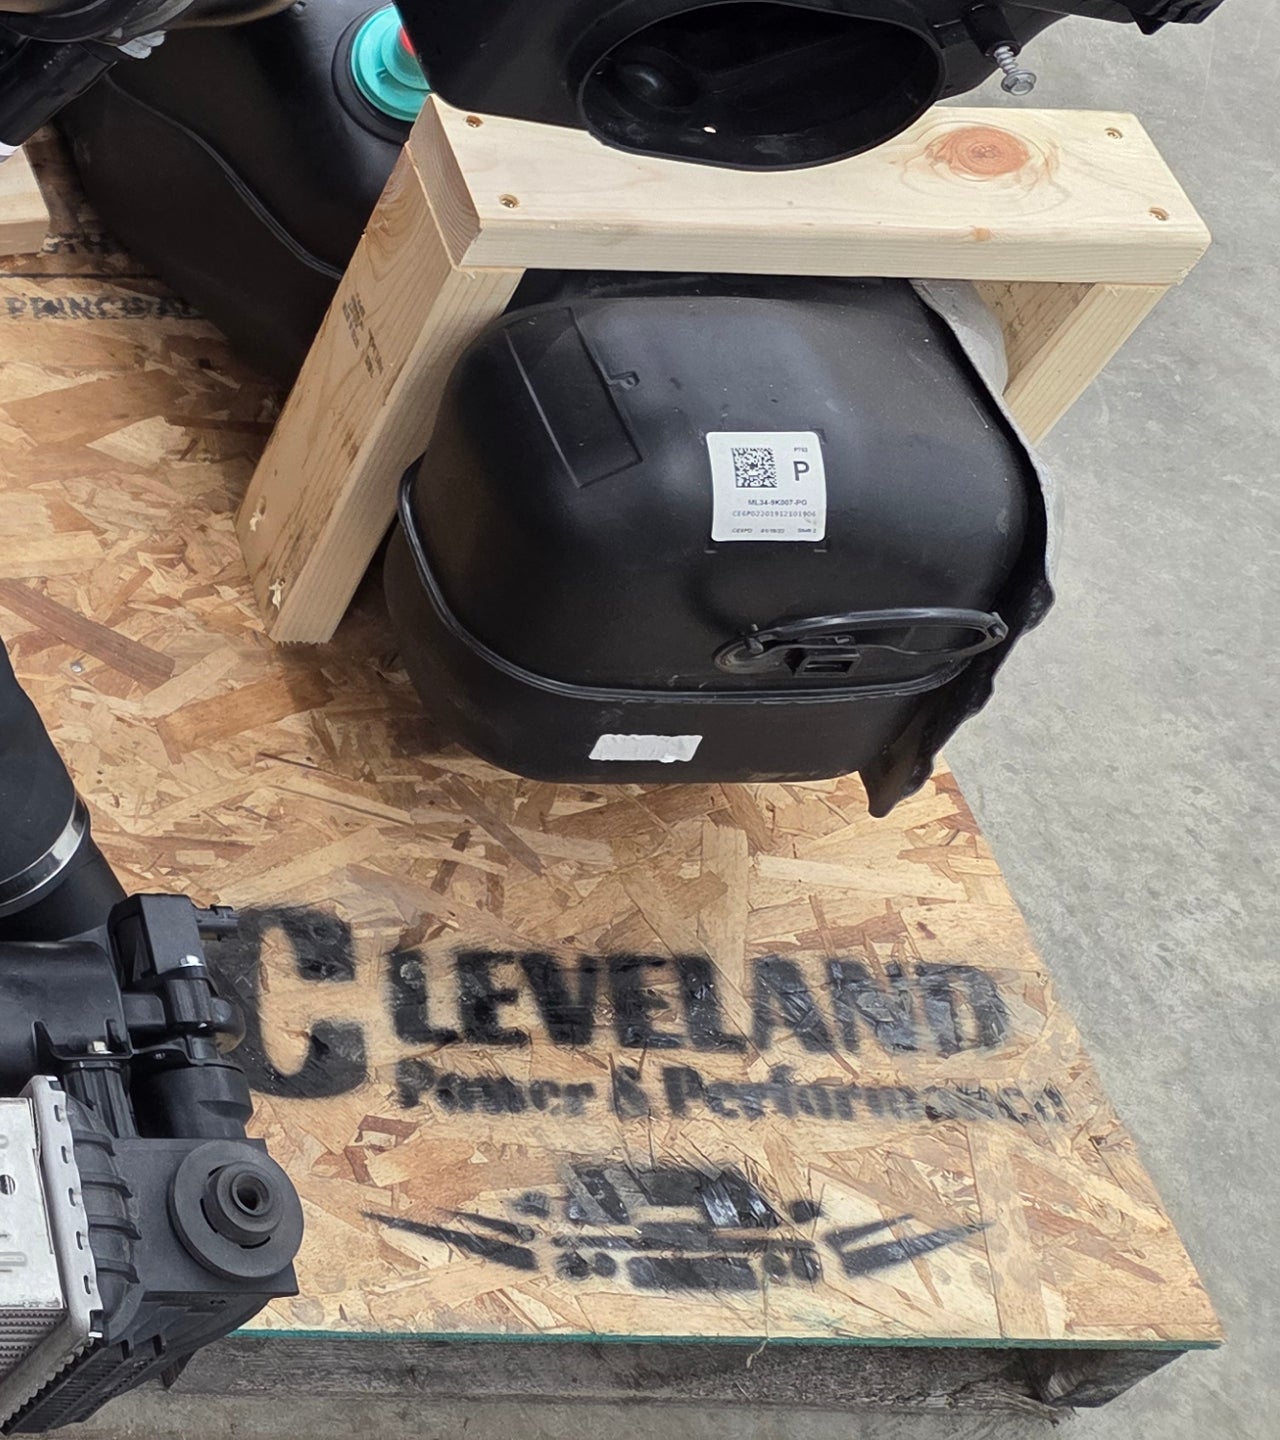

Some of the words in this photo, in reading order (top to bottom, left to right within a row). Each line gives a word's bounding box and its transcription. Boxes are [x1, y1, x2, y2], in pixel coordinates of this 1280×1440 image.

[793, 460, 810, 482] P
[222, 905, 1012, 1100] CLEVELAND
[395, 1059, 600, 1117] Power
[610, 1064, 656, 1124] &
[662, 1064, 1068, 1126] Performance
